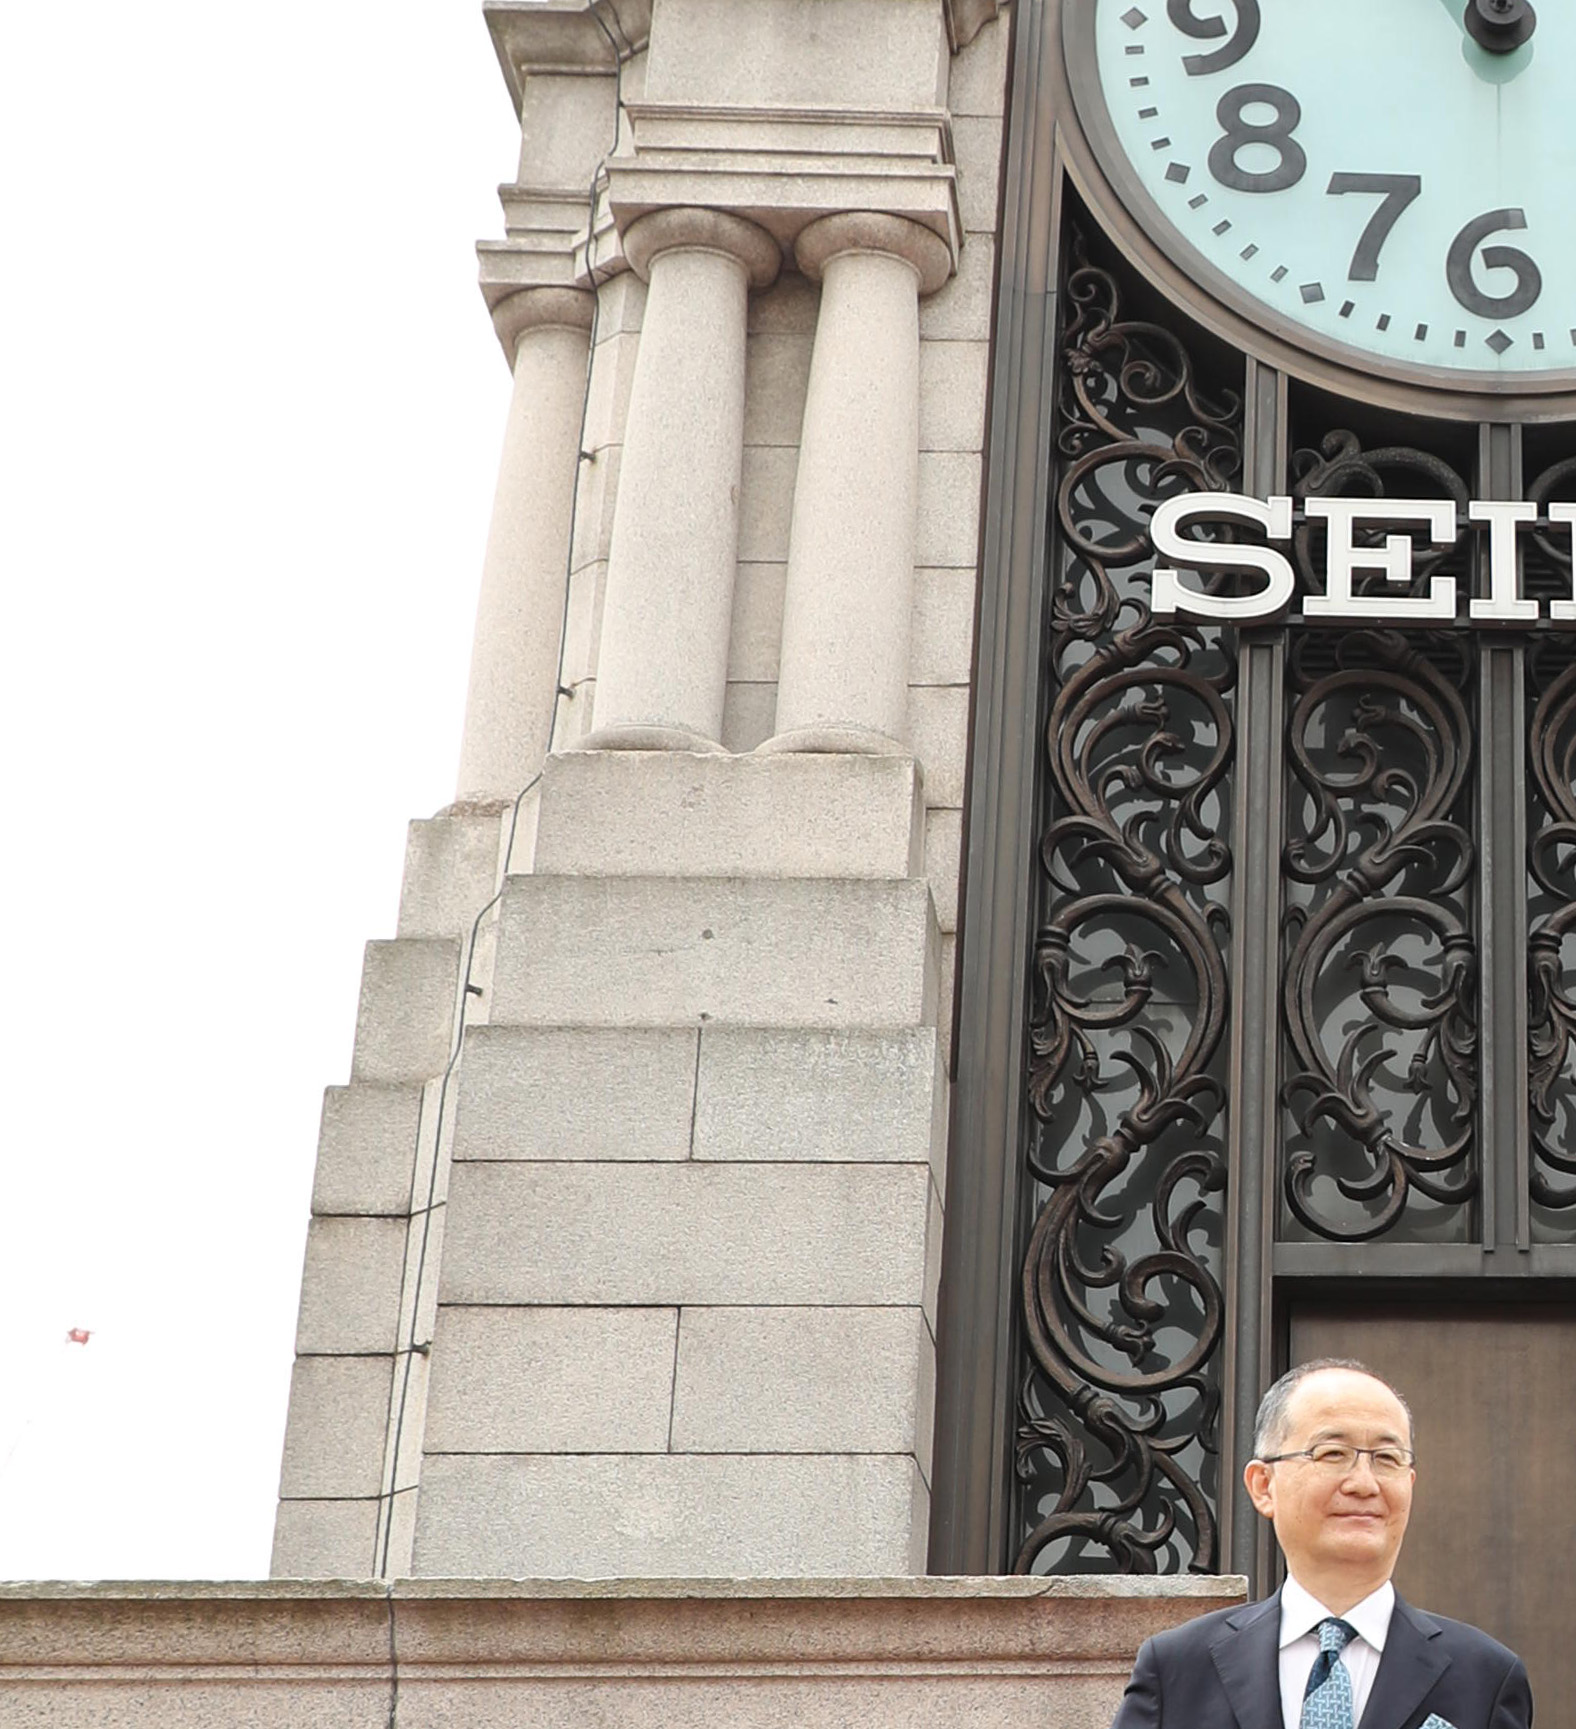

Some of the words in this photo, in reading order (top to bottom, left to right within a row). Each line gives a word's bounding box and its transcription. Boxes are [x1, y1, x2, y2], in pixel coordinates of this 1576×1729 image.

[1207, 83, 1307, 194] 8
[1326, 171, 1422, 282] 7
[1445, 208, 1543, 321] 6
